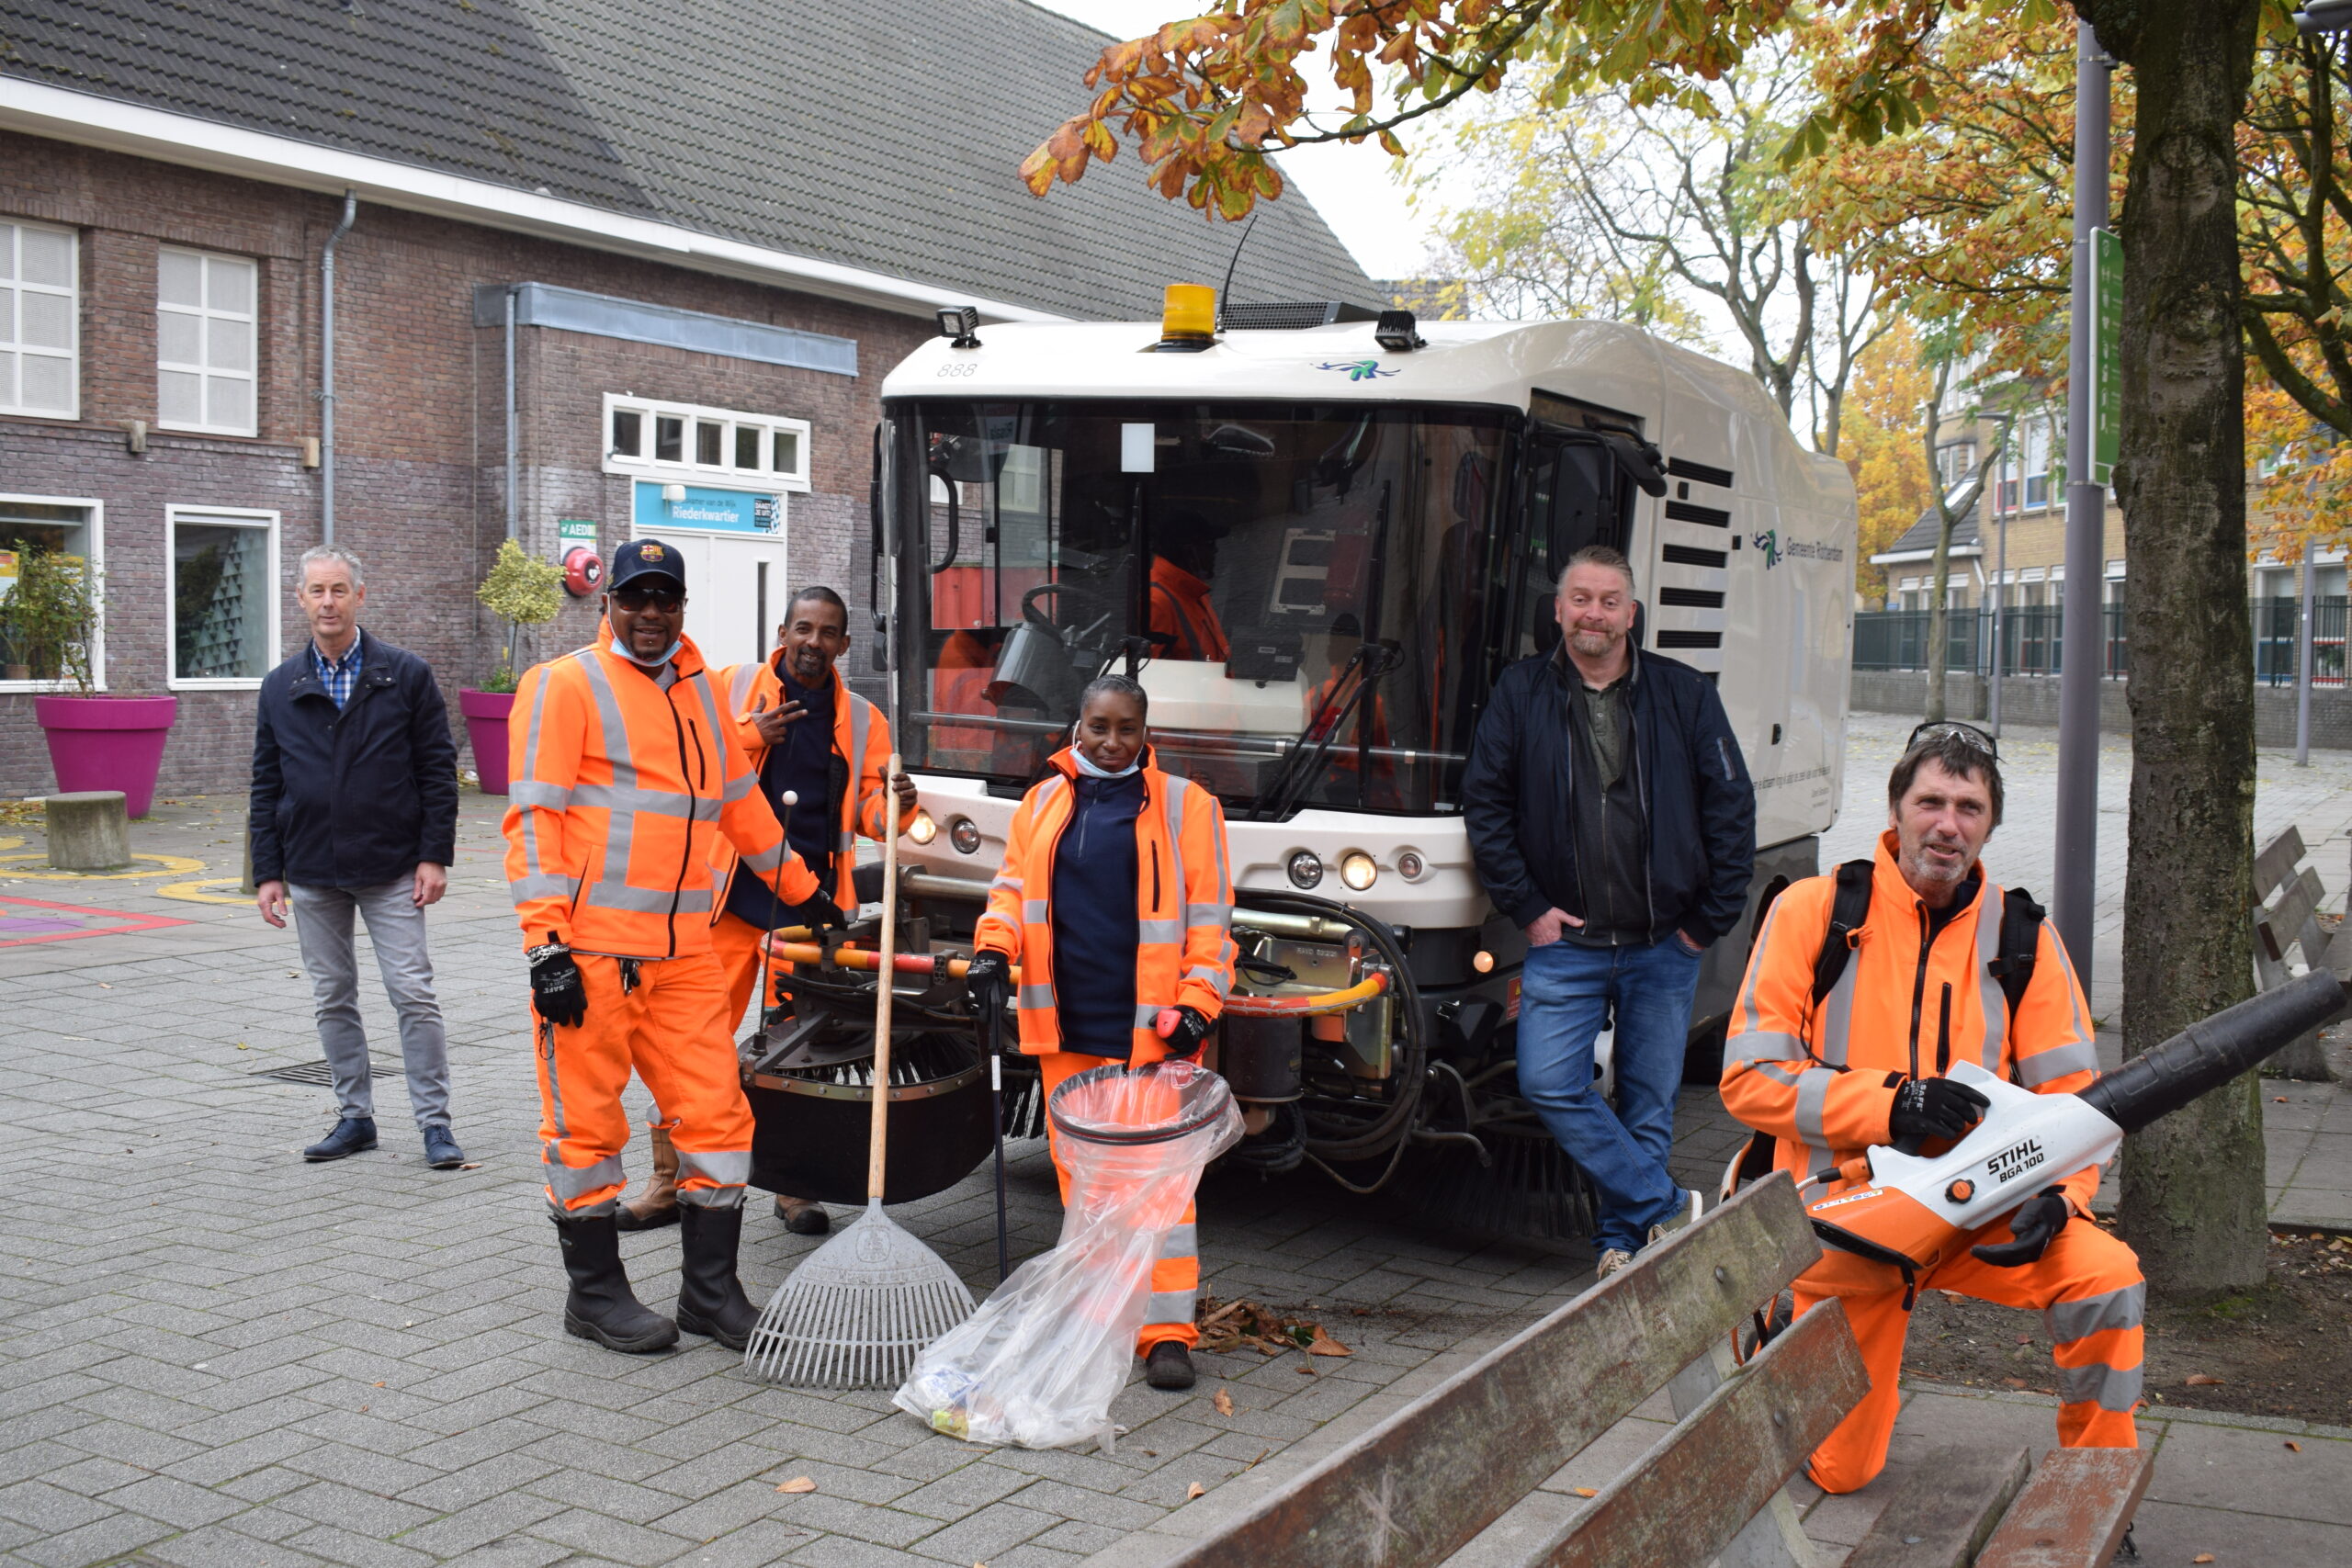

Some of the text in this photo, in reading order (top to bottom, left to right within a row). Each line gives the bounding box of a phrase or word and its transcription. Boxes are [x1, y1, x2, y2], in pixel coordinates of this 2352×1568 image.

[937, 364, 978, 377] 888
[672, 505, 740, 523] Riederkwartier
[569, 524, 588, 536] AED
[1787, 536, 1815, 559] Gemeente
[544, 985, 565, 993] SAFE
[1917, 1084, 1927, 1109] SAFE
[1987, 1139, 2041, 1175] STIHL
[1999, 1153, 2044, 1183] BGA 100
